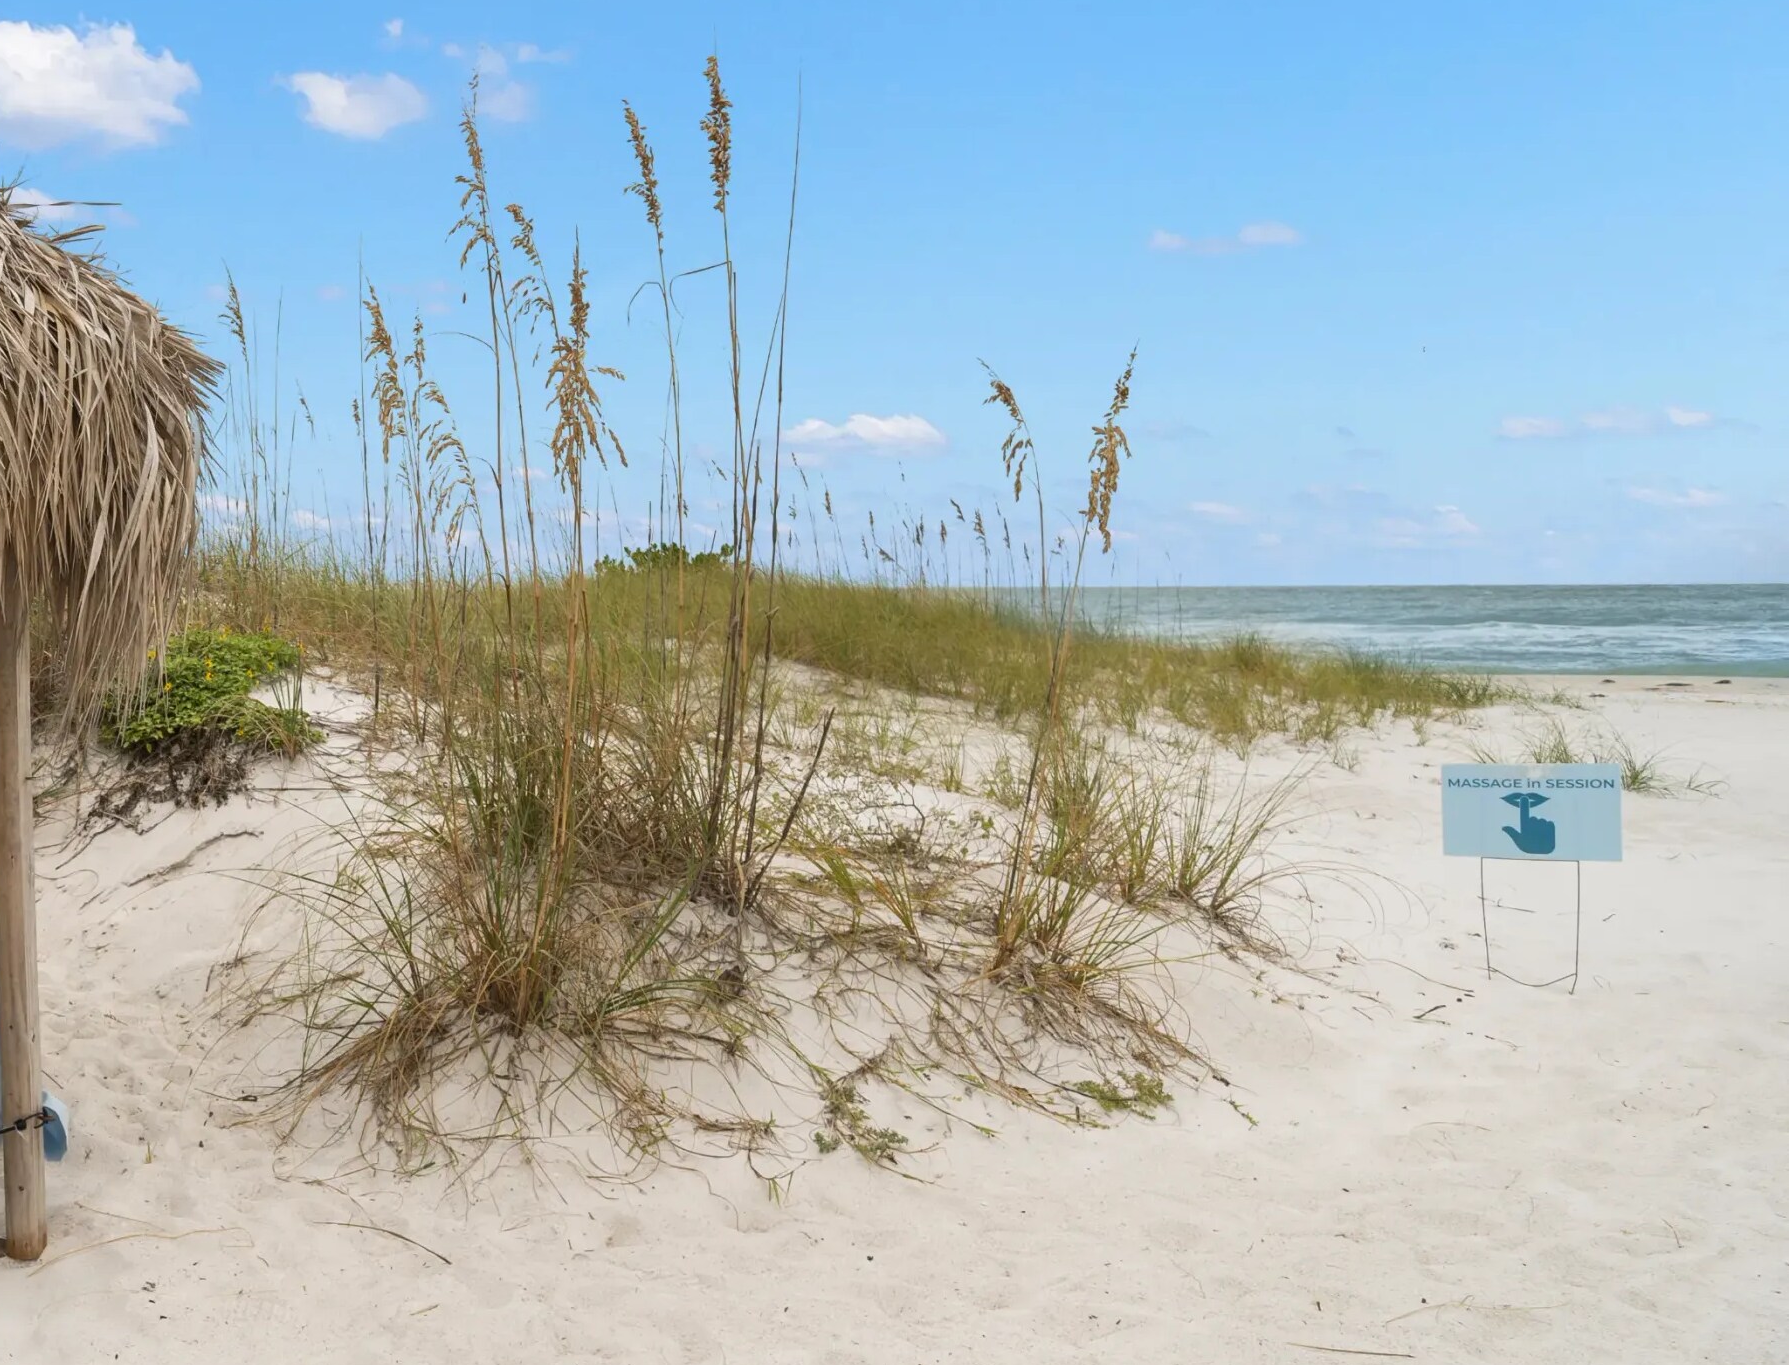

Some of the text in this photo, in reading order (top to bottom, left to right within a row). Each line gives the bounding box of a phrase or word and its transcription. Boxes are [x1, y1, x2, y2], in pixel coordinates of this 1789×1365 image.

[1447, 778, 1615, 789] MASSAGE in SESSION
